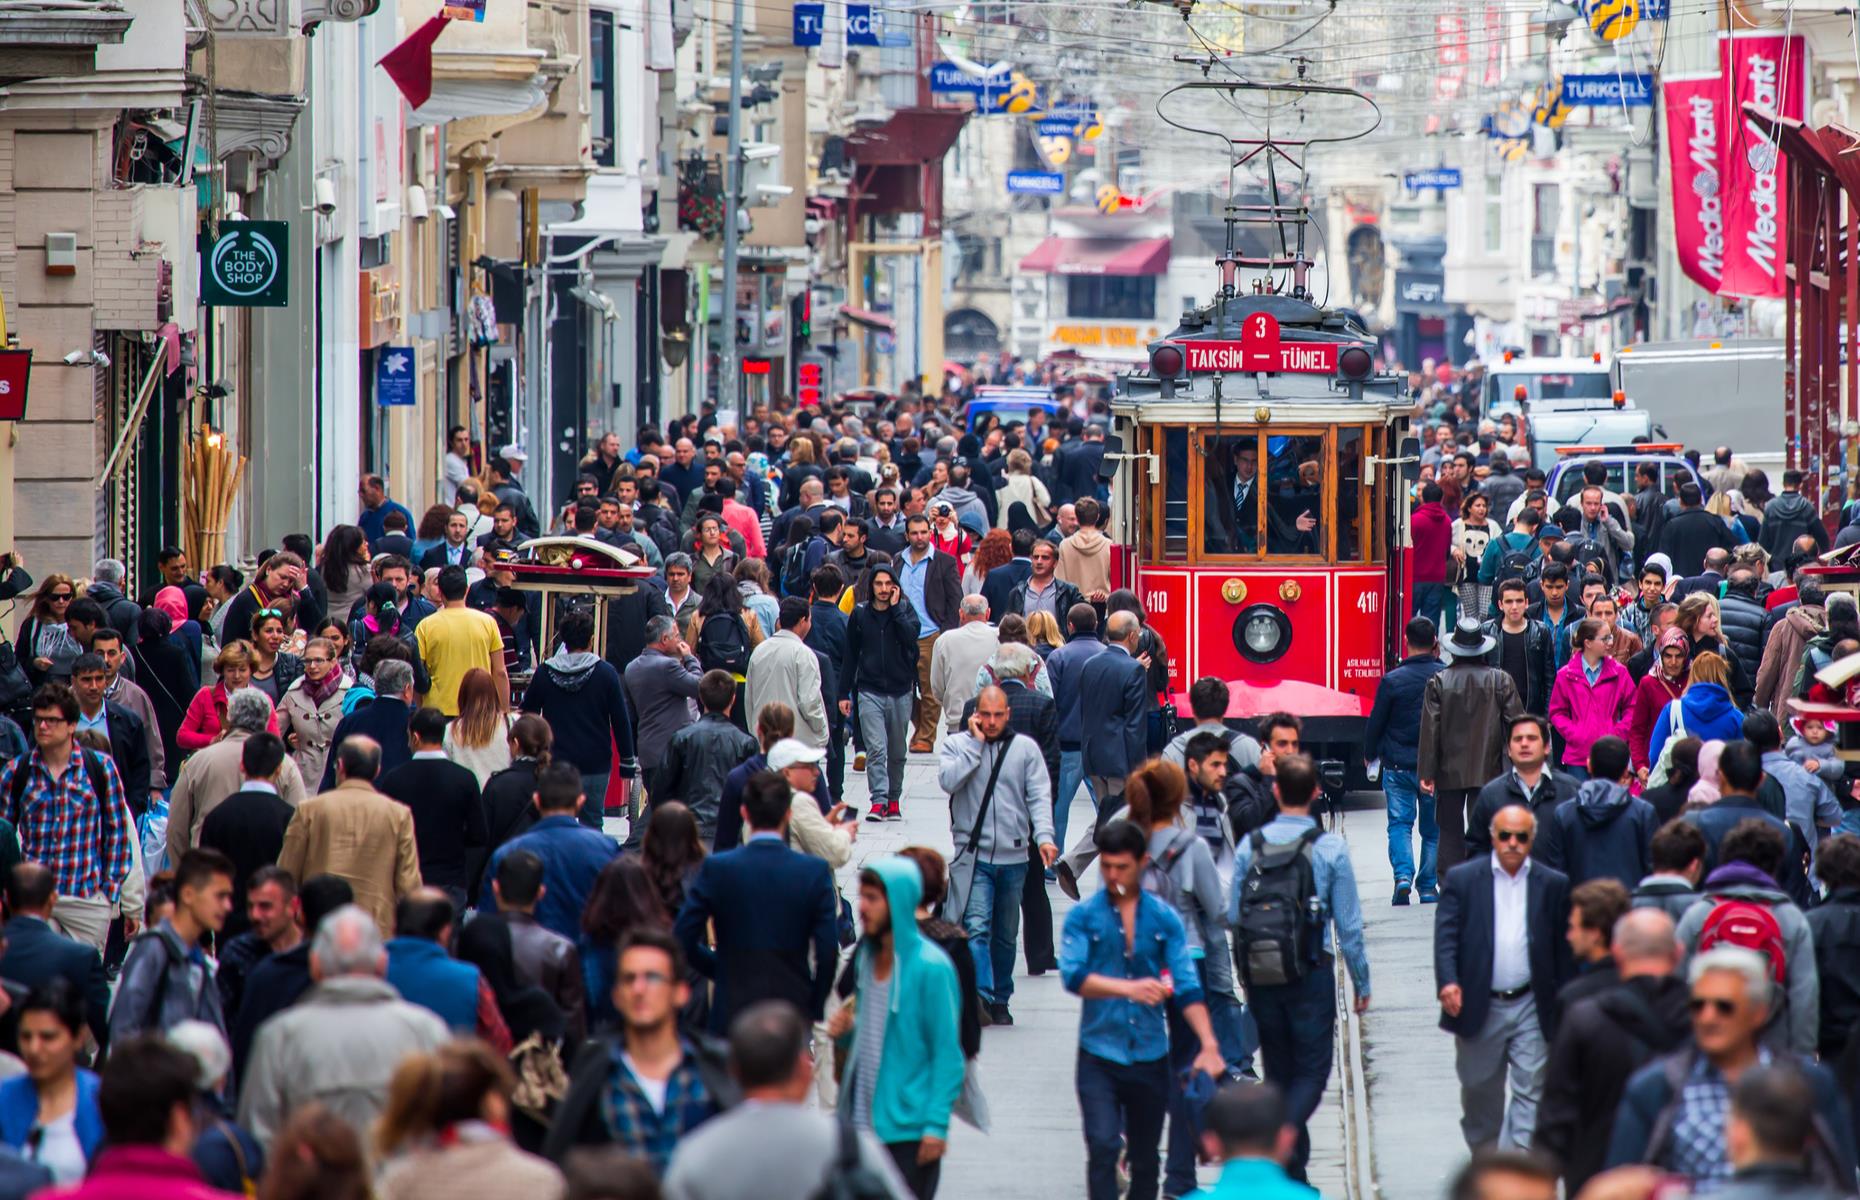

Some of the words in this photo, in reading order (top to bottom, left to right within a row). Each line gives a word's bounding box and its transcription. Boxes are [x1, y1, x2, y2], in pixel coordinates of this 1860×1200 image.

[1566, 81, 1649, 98] TURKCELL
[233, 250, 256, 260] THE
[224, 261, 265, 272] BODY
[227, 273, 263, 284] SHOP
[1255, 316, 1266, 338] 3
[1280, 347, 1331, 370] TÜNEL
[1146, 590, 1167, 613] 410
[1357, 591, 1378, 613] 410
